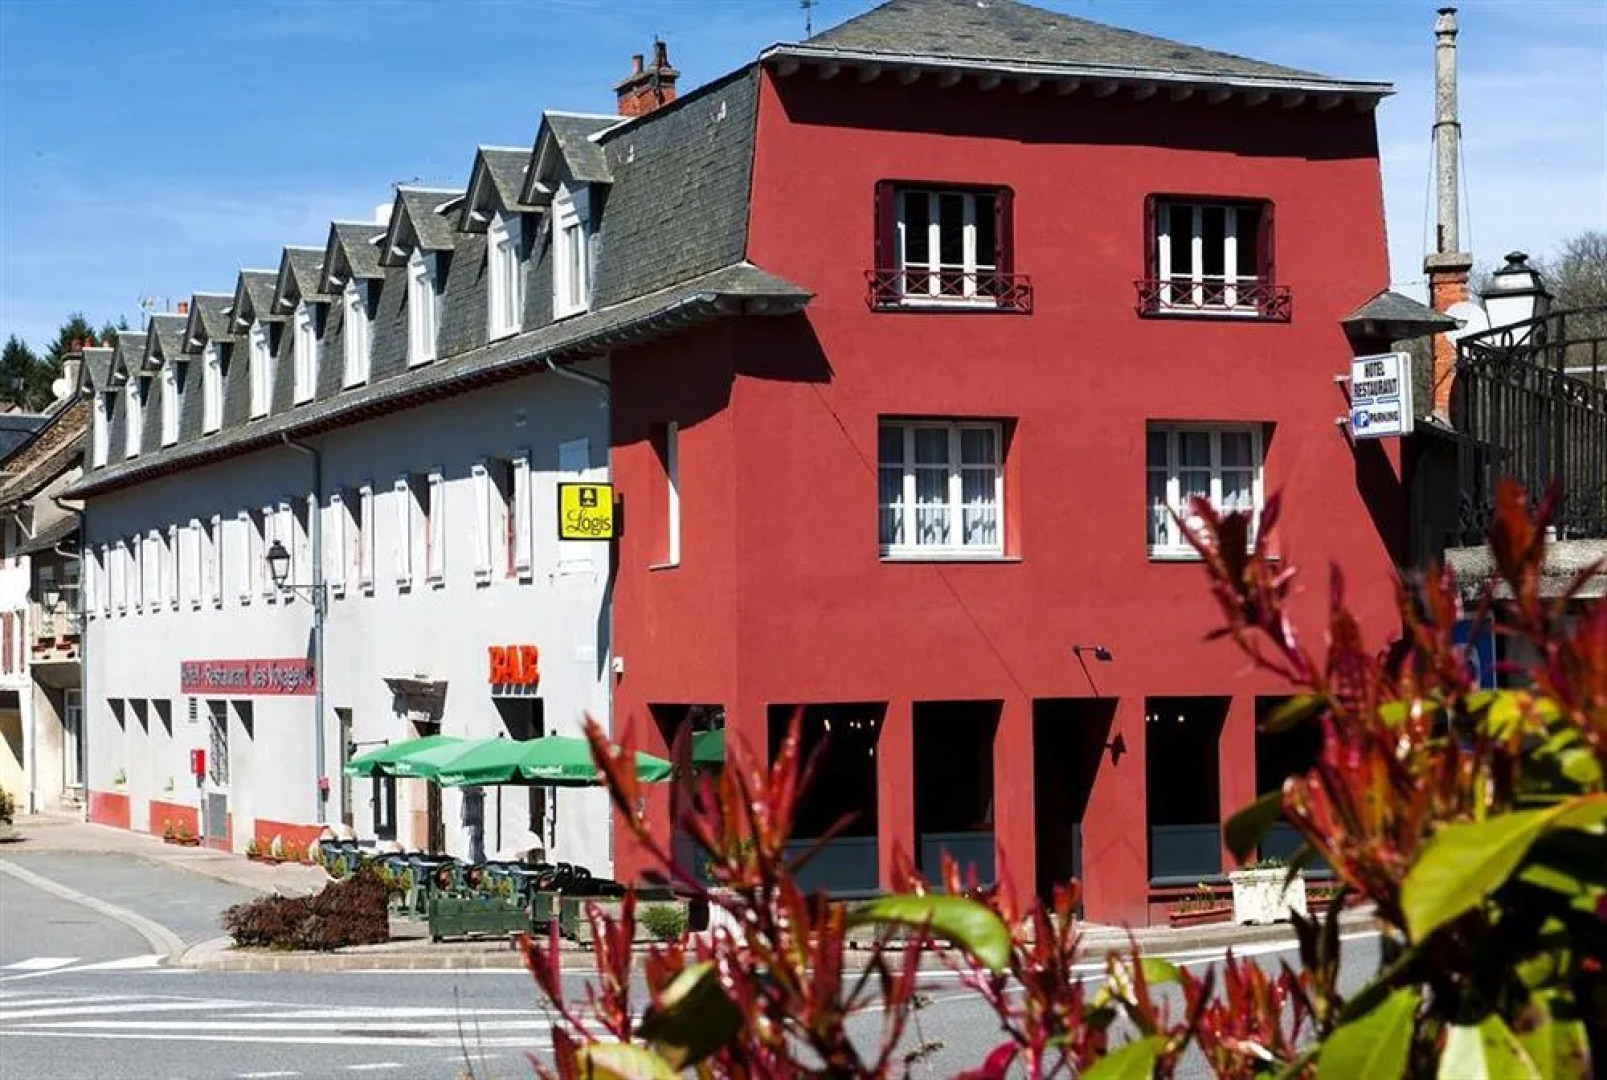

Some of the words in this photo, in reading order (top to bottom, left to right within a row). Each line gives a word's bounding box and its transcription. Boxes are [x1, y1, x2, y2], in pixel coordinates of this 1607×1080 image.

[1354, 378, 1397, 397] RESTAURANT
[1370, 411, 1399, 422] PARKING
[566, 507, 611, 535] Logis
[488, 645, 540, 684] BAR
